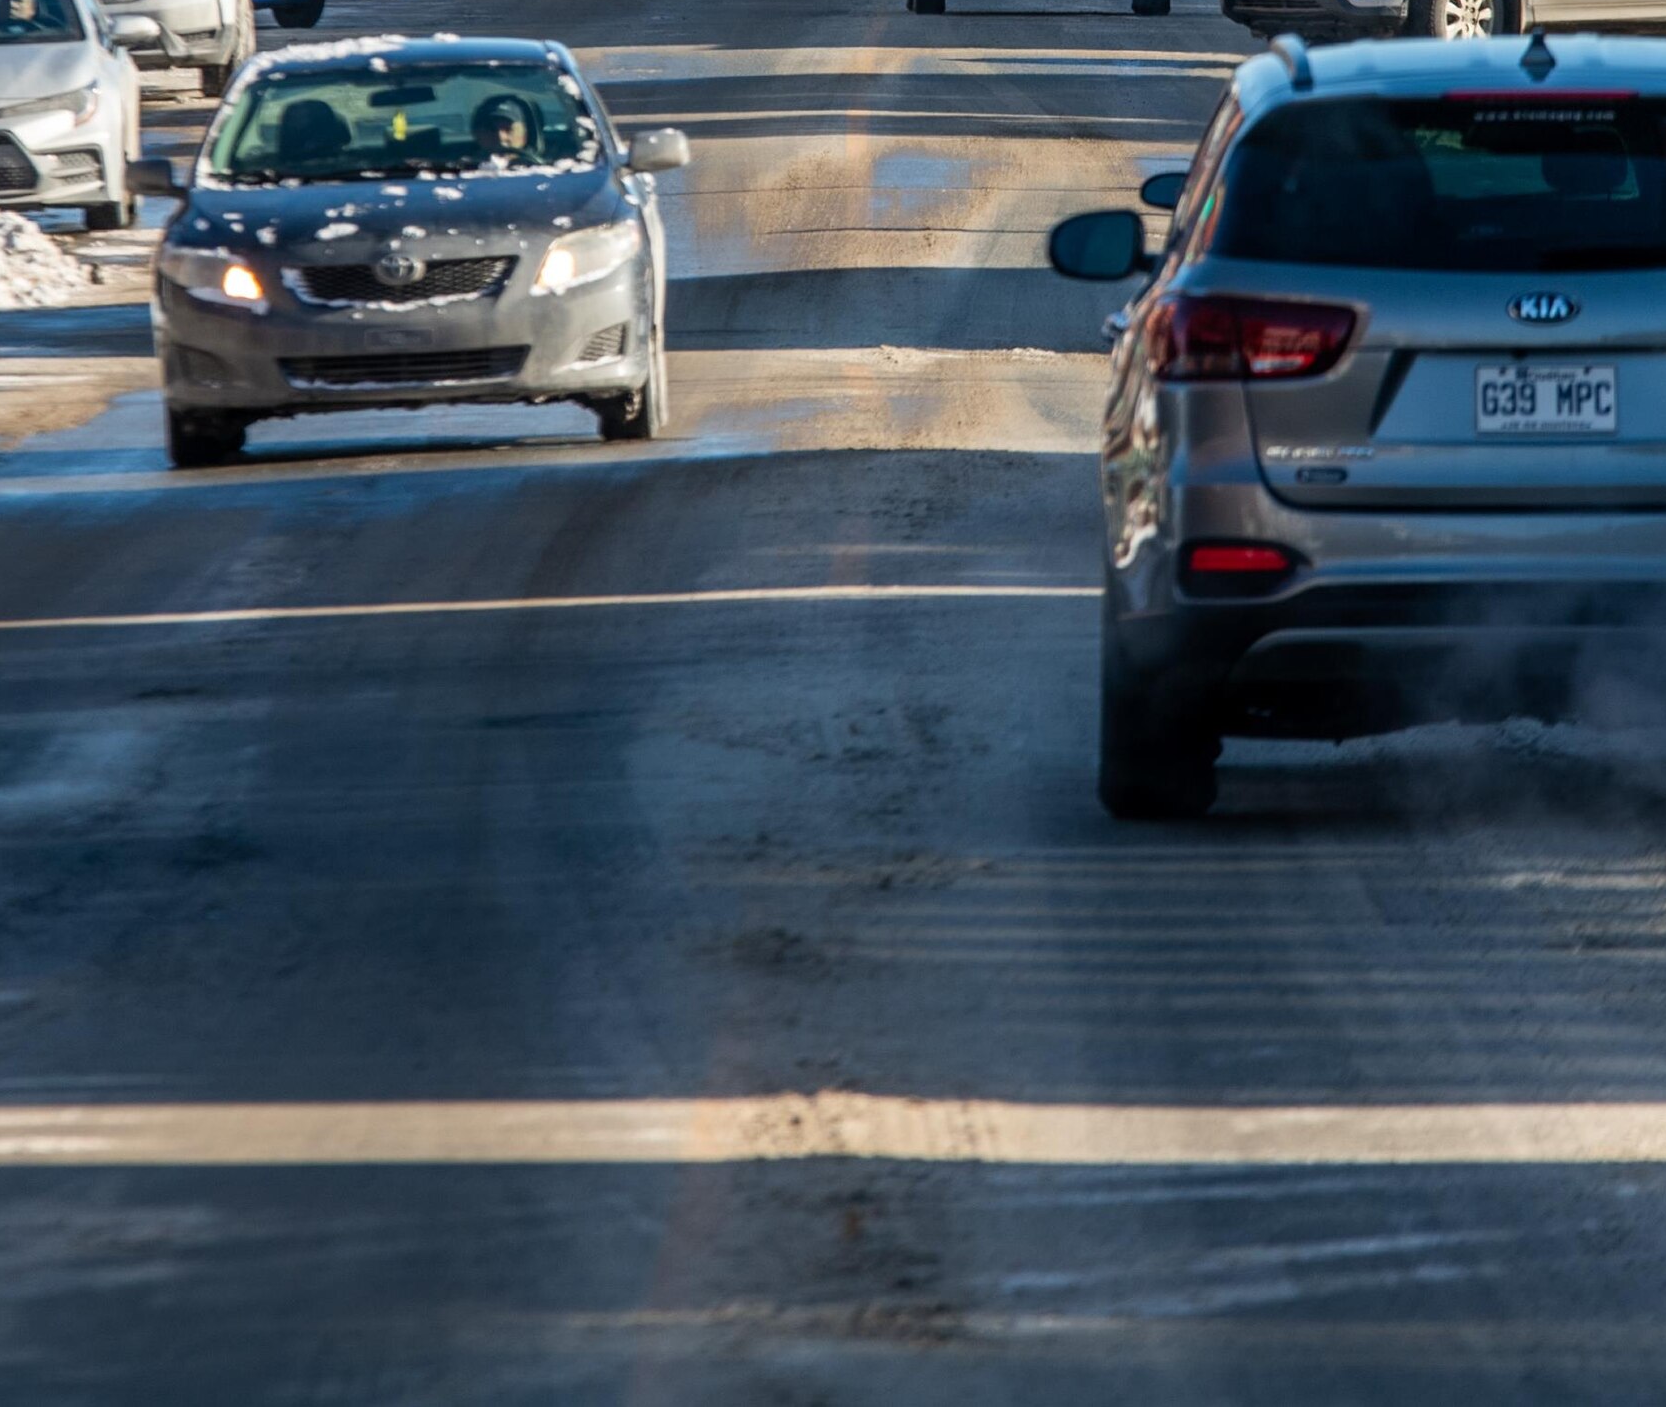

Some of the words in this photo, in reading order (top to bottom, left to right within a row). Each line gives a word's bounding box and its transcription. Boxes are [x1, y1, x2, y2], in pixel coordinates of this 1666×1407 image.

[1520, 296, 1570, 319] KIA
[1483, 381, 1537, 417] G39
[1556, 381, 1612, 417] MPC
